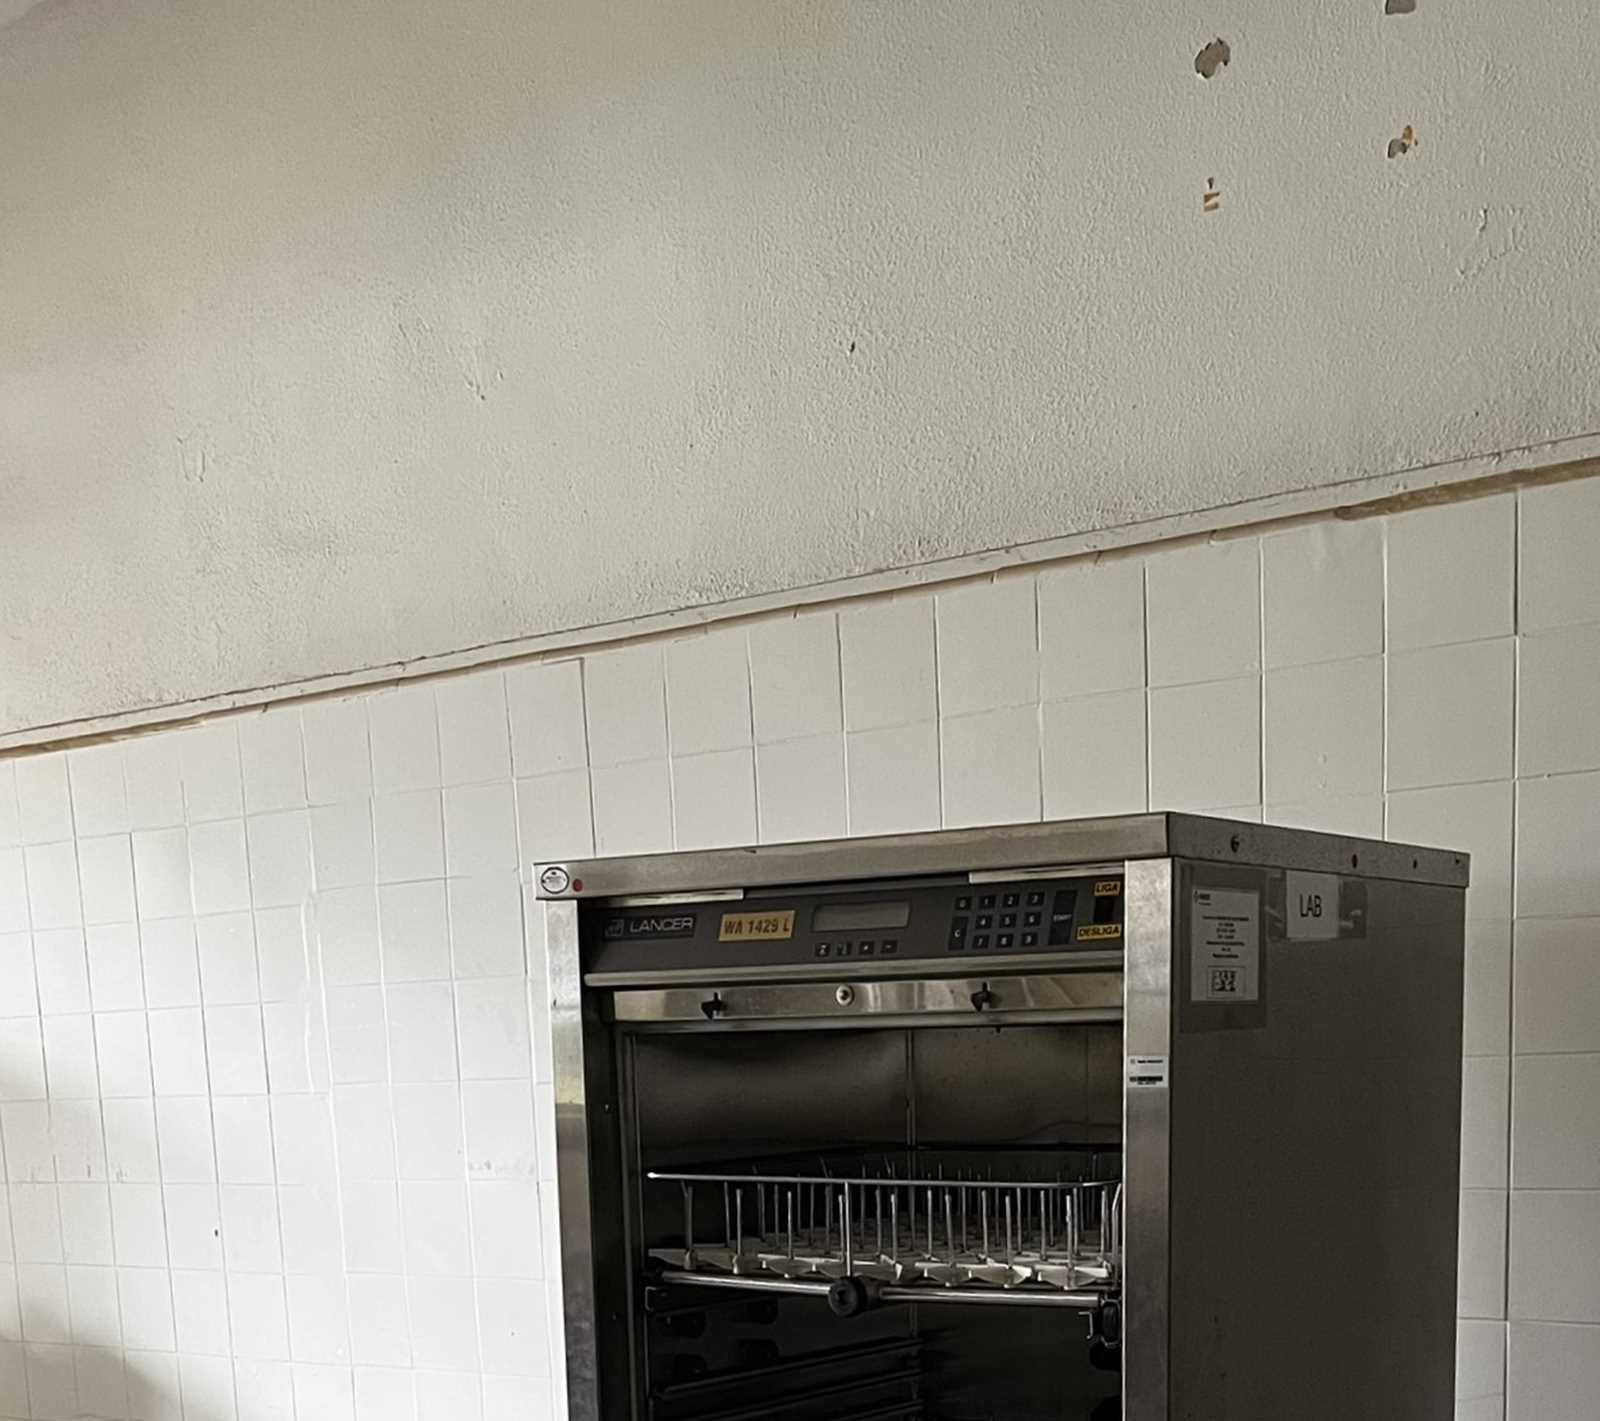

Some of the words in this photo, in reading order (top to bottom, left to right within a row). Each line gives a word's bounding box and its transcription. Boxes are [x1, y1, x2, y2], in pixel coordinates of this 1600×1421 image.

[1096, 884, 1118, 893] LIGA
[1299, 894, 1323, 918] LAB
[629, 916, 694, 933] LANCER
[724, 919, 743, 935] WA
[782, 917, 790, 932] L
[1079, 926, 1120, 937] DESLIGA
